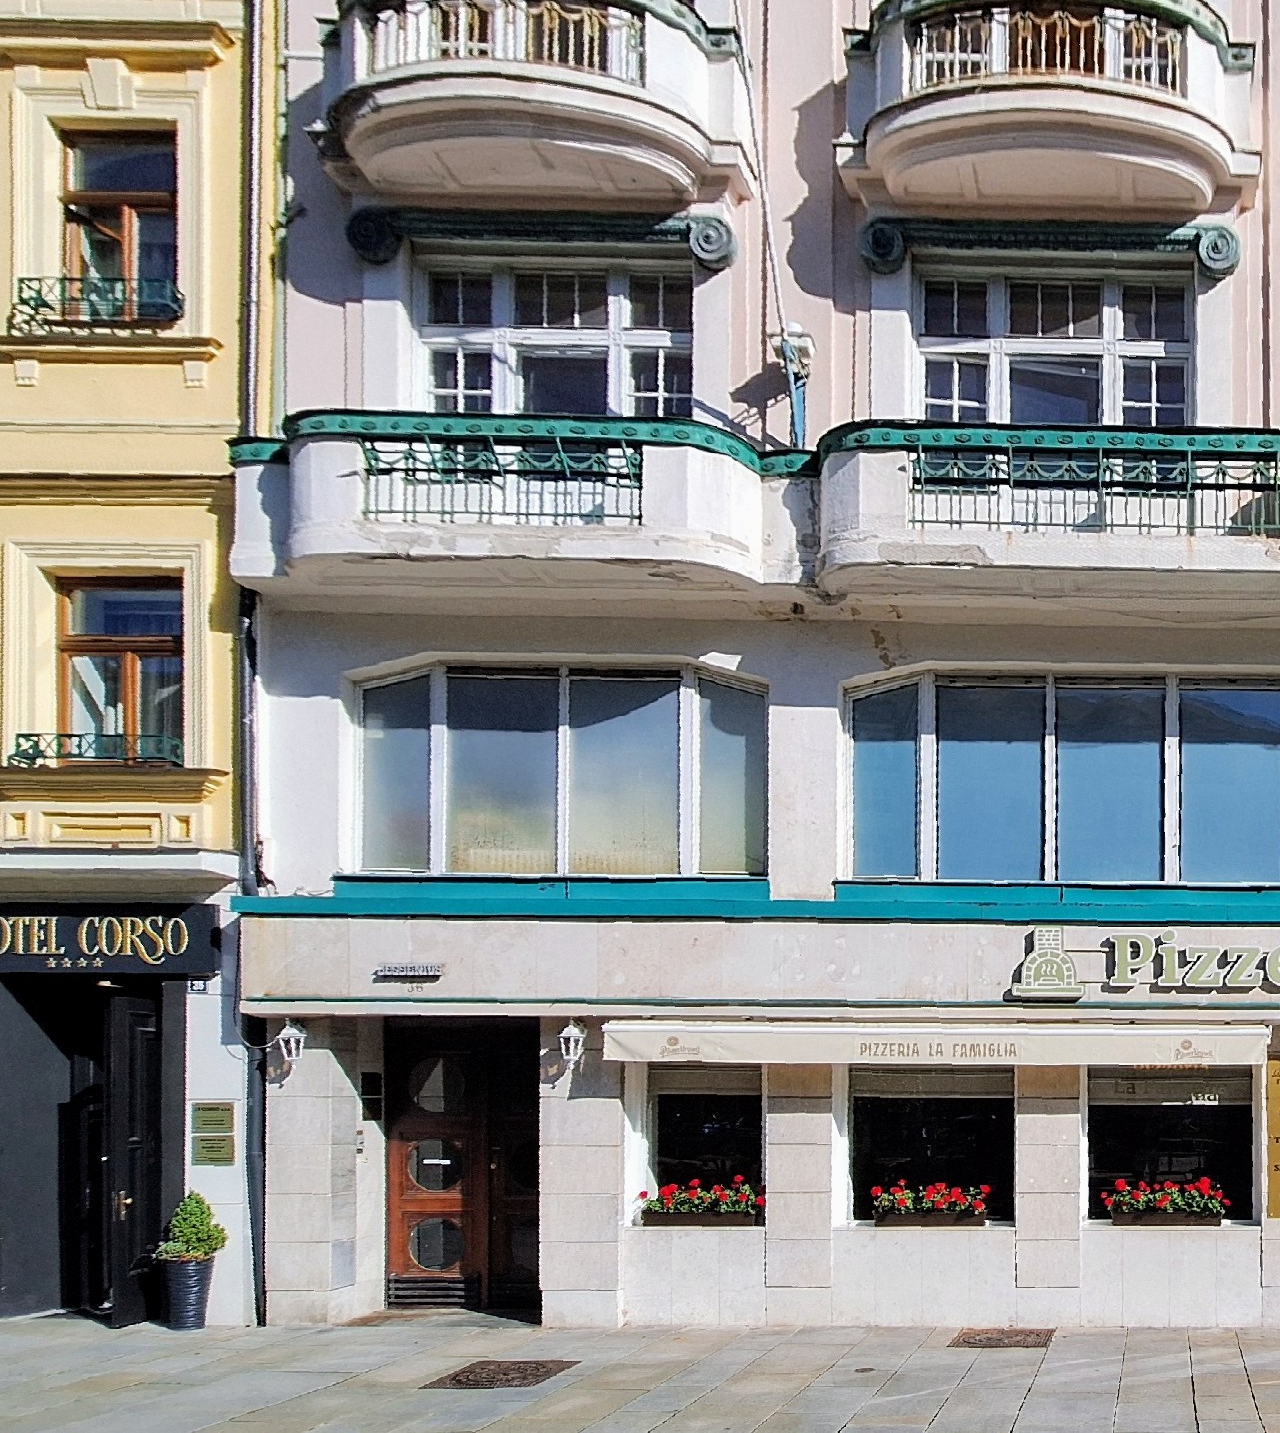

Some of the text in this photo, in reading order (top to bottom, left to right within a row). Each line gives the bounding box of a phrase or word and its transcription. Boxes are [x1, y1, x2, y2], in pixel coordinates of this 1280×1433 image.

[77, 915, 189, 965] CORSO
[859, 1042, 1018, 1058] PIZZERIA LA FAMIGLIA
